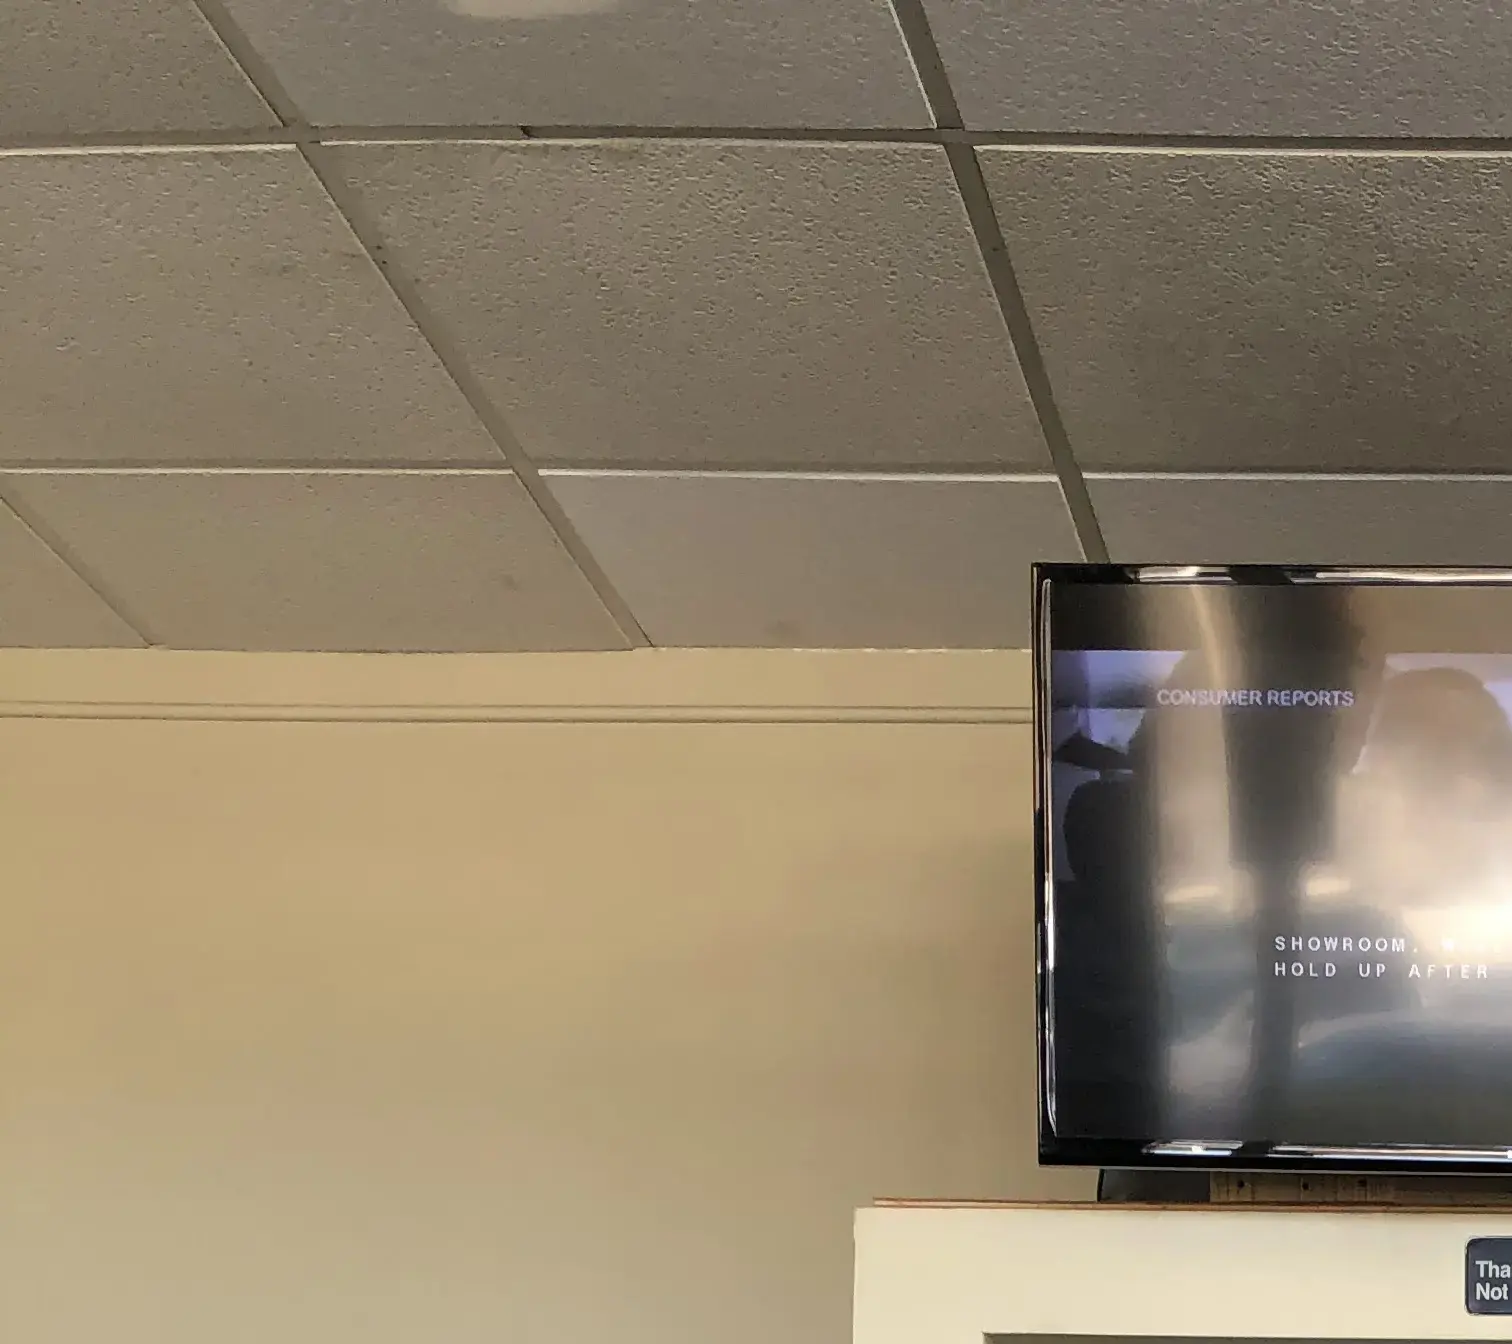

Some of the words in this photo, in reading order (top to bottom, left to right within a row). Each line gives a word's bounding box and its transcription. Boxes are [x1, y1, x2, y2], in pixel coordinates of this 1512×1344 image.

[1156, 689, 1262, 706] CONSUMER
[1267, 689, 1355, 707] REPORTS
[1274, 962, 1337, 978] HOLD
[1358, 963, 1387, 978] UP
[1408, 963, 1488, 979] AFTER
[1475, 1283, 1508, 1301] Not
